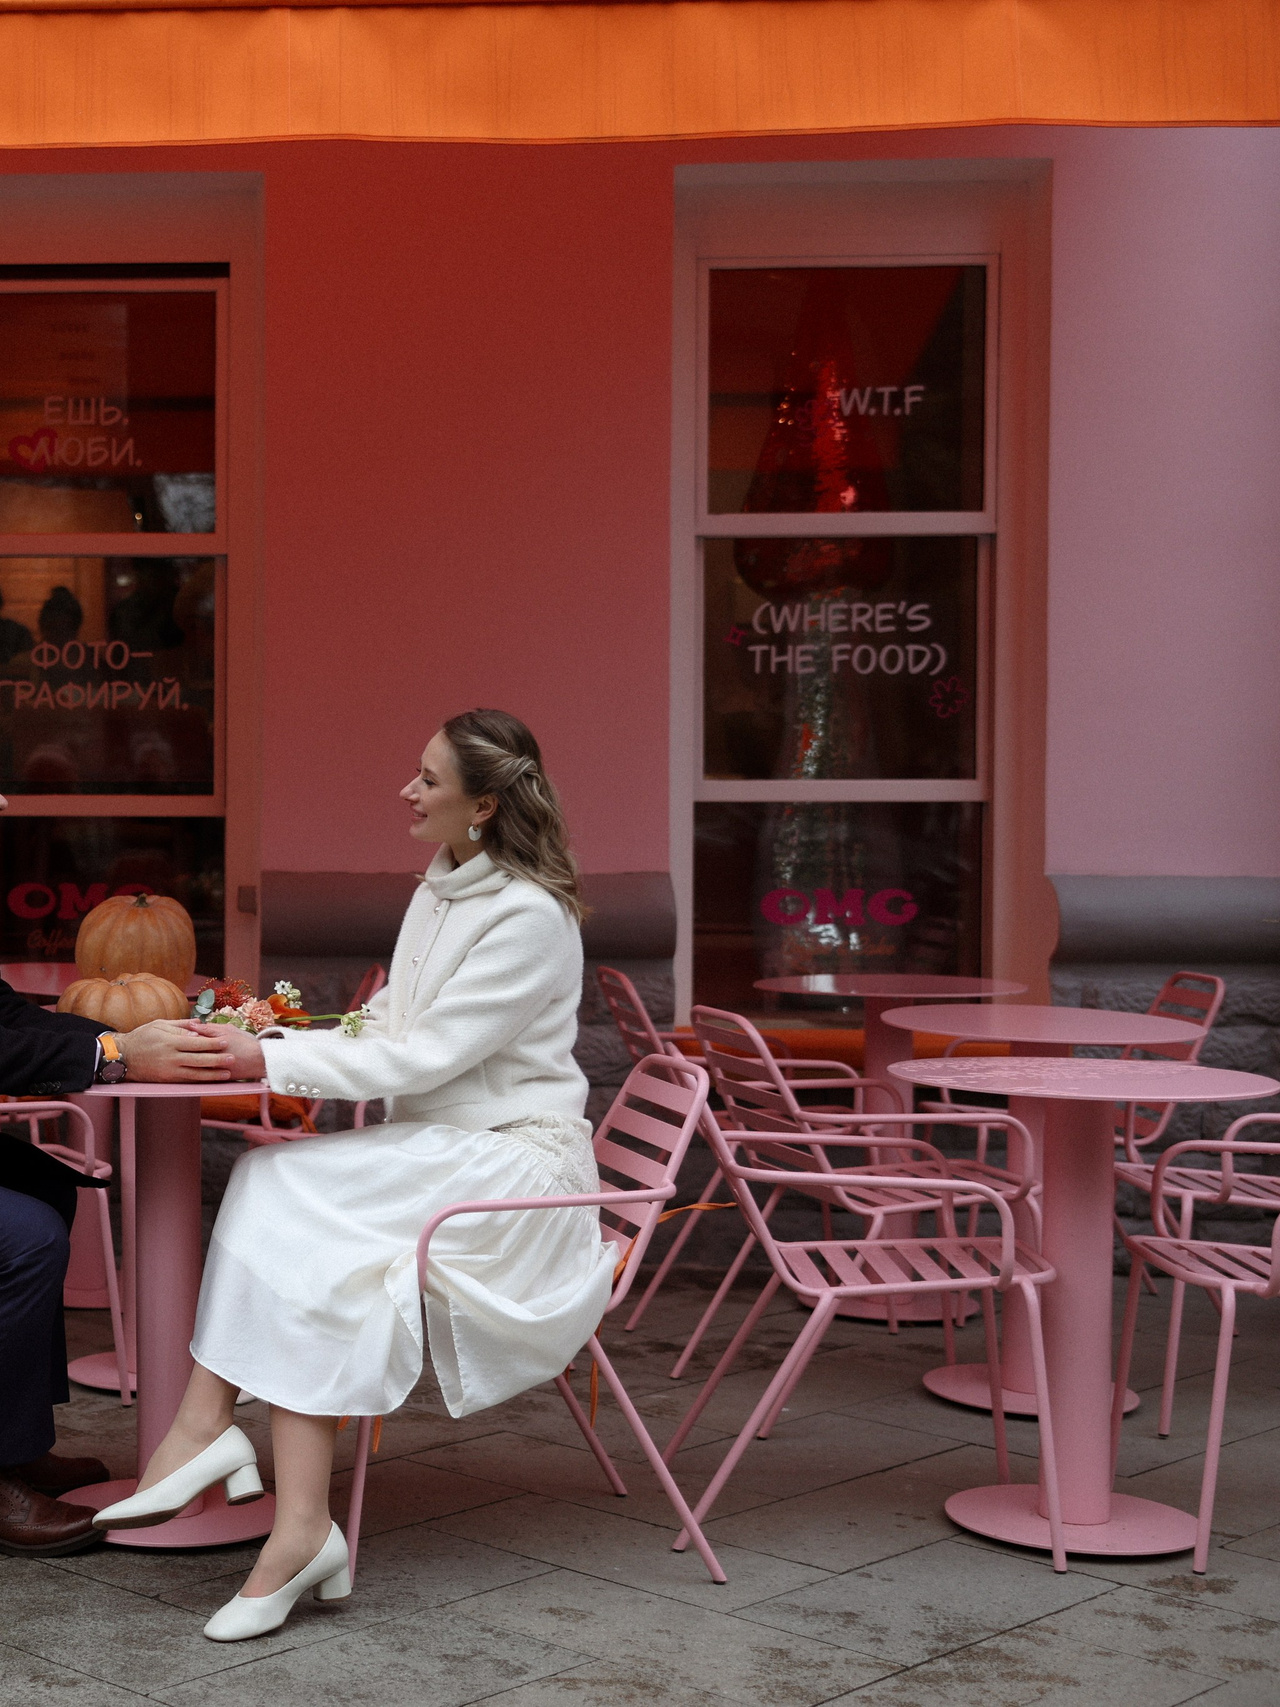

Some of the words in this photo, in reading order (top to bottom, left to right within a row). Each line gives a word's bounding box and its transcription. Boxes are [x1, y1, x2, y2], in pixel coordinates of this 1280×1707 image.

[839, 385, 926, 417] W.T.F
[752, 601, 933, 635] (WHERE'S
[748, 644, 816, 675] THE
[831, 643, 947, 676] FOOD)
[7, 882, 154, 920] OM
[760, 887, 919, 926] OMG
